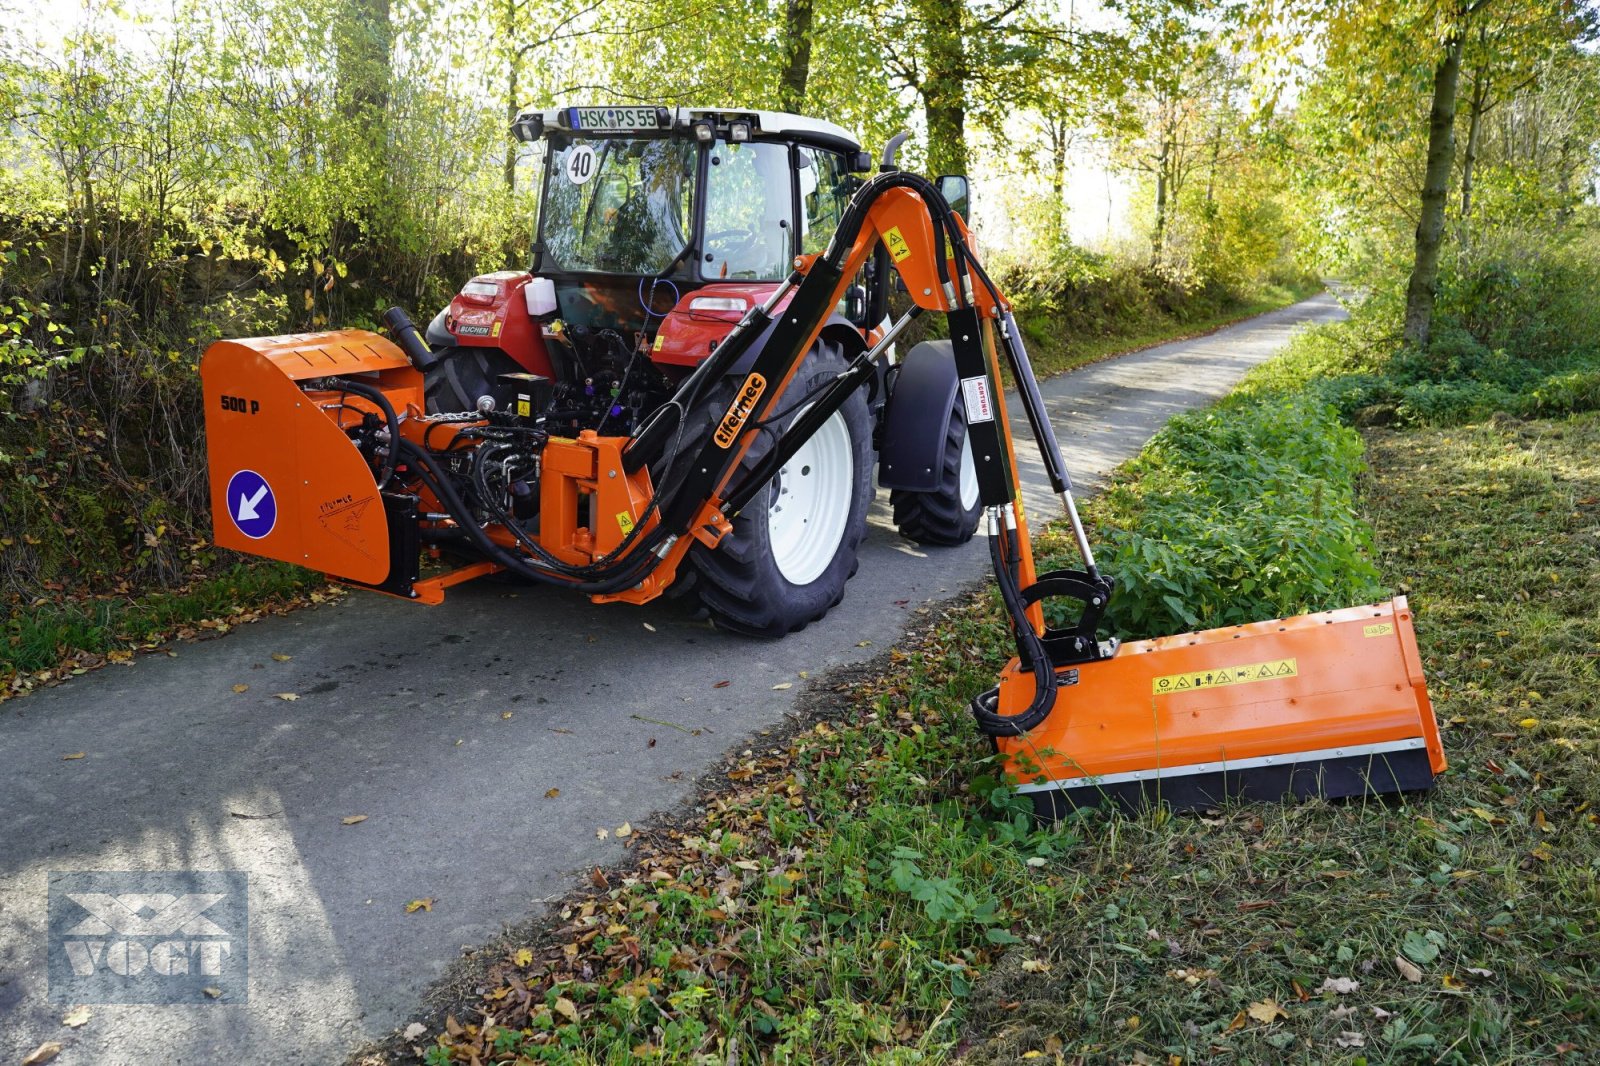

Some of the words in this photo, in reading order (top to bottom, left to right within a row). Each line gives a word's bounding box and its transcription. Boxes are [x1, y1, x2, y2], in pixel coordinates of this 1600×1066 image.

[579, 110, 608, 127] HSK
[615, 109, 635, 127] PS
[637, 109, 657, 127] 55
[571, 152, 591, 177] 40
[460, 325, 489, 334] BUCHEN
[221, 395, 247, 413] 500
[251, 400, 260, 415] P
[716, 377, 763, 443] tifermec
